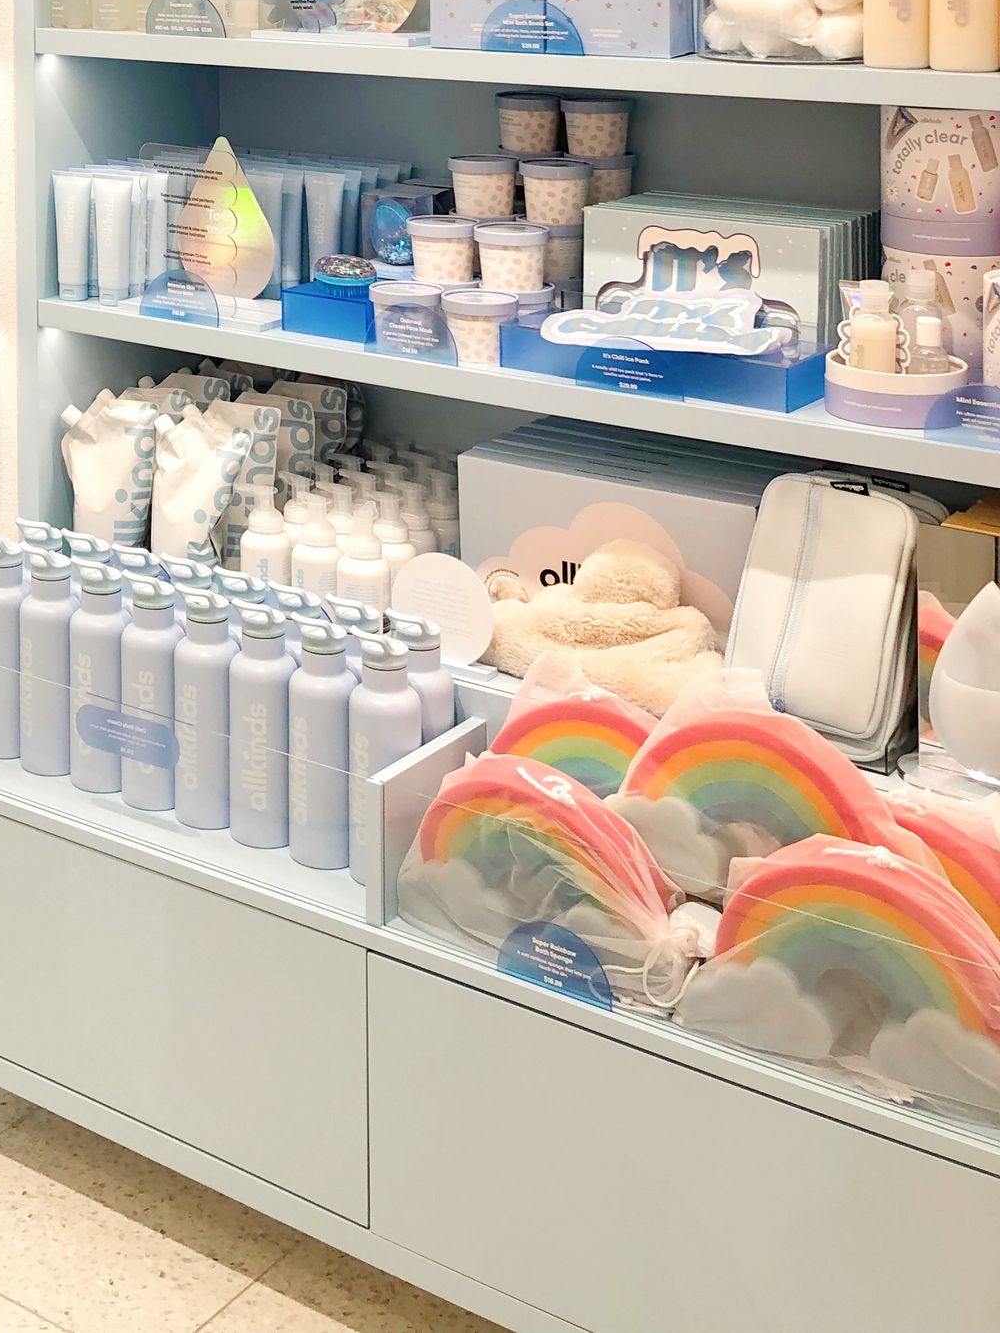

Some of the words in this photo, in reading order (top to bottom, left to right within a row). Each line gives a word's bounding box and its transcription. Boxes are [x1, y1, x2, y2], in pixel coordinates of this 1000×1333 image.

[892, 134, 923, 175] totally
[924, 129, 969, 149] clear
[178, 682, 198, 793] allkinds
[241, 701, 268, 812] allkinds
[289, 715, 308, 827] allkinds
